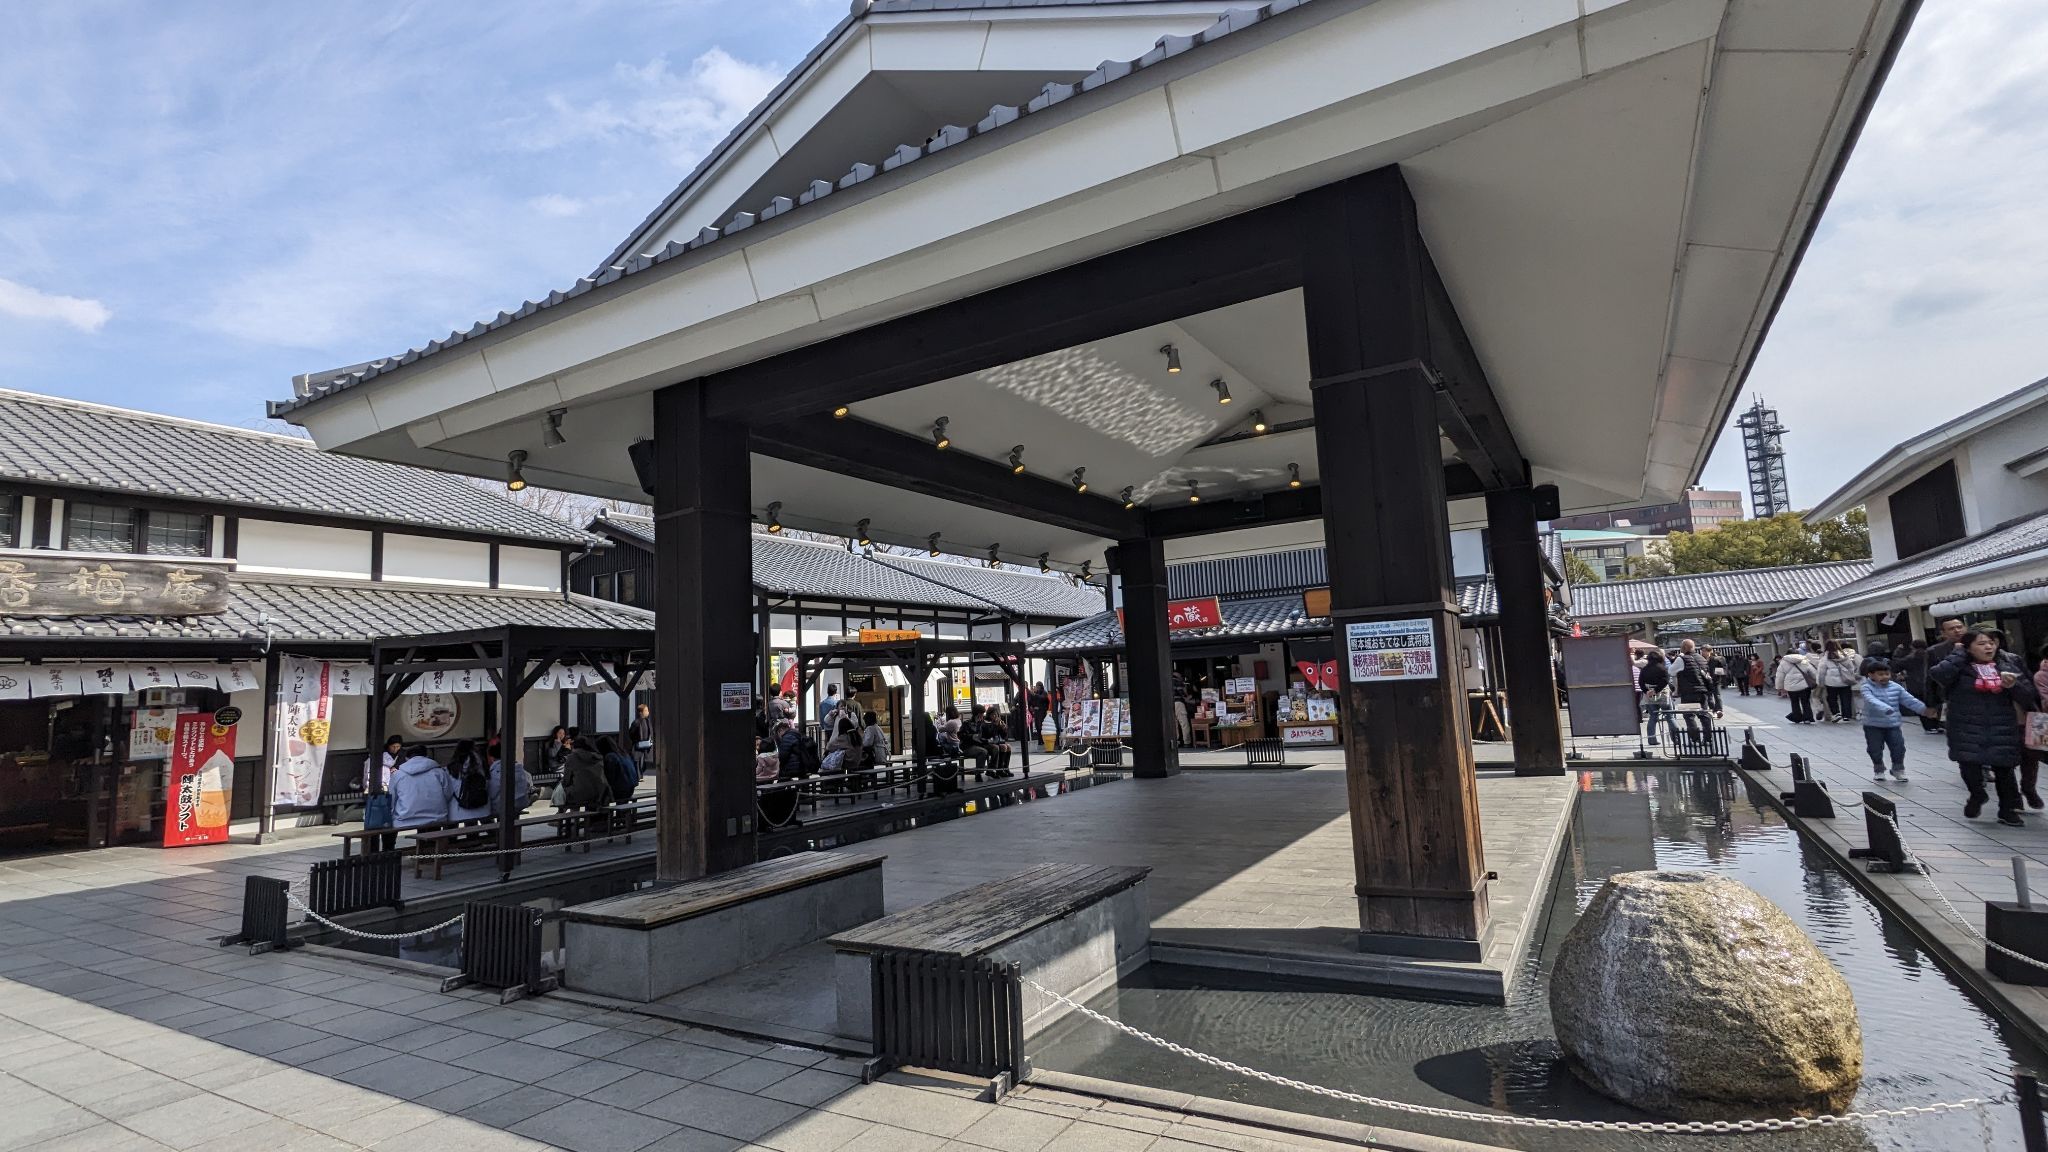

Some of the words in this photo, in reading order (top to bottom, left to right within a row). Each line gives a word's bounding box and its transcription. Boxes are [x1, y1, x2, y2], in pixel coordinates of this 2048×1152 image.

[1168, 605, 1202, 624] の蔵
[1350, 634, 1431, 651] 熊本城おもてなし武将隊
[1353, 665, 1380, 678] 11:30AM
[1403, 663, 1433, 676] 14:30PM
[179, 773, 194, 831] 陣太鼓ソフト
